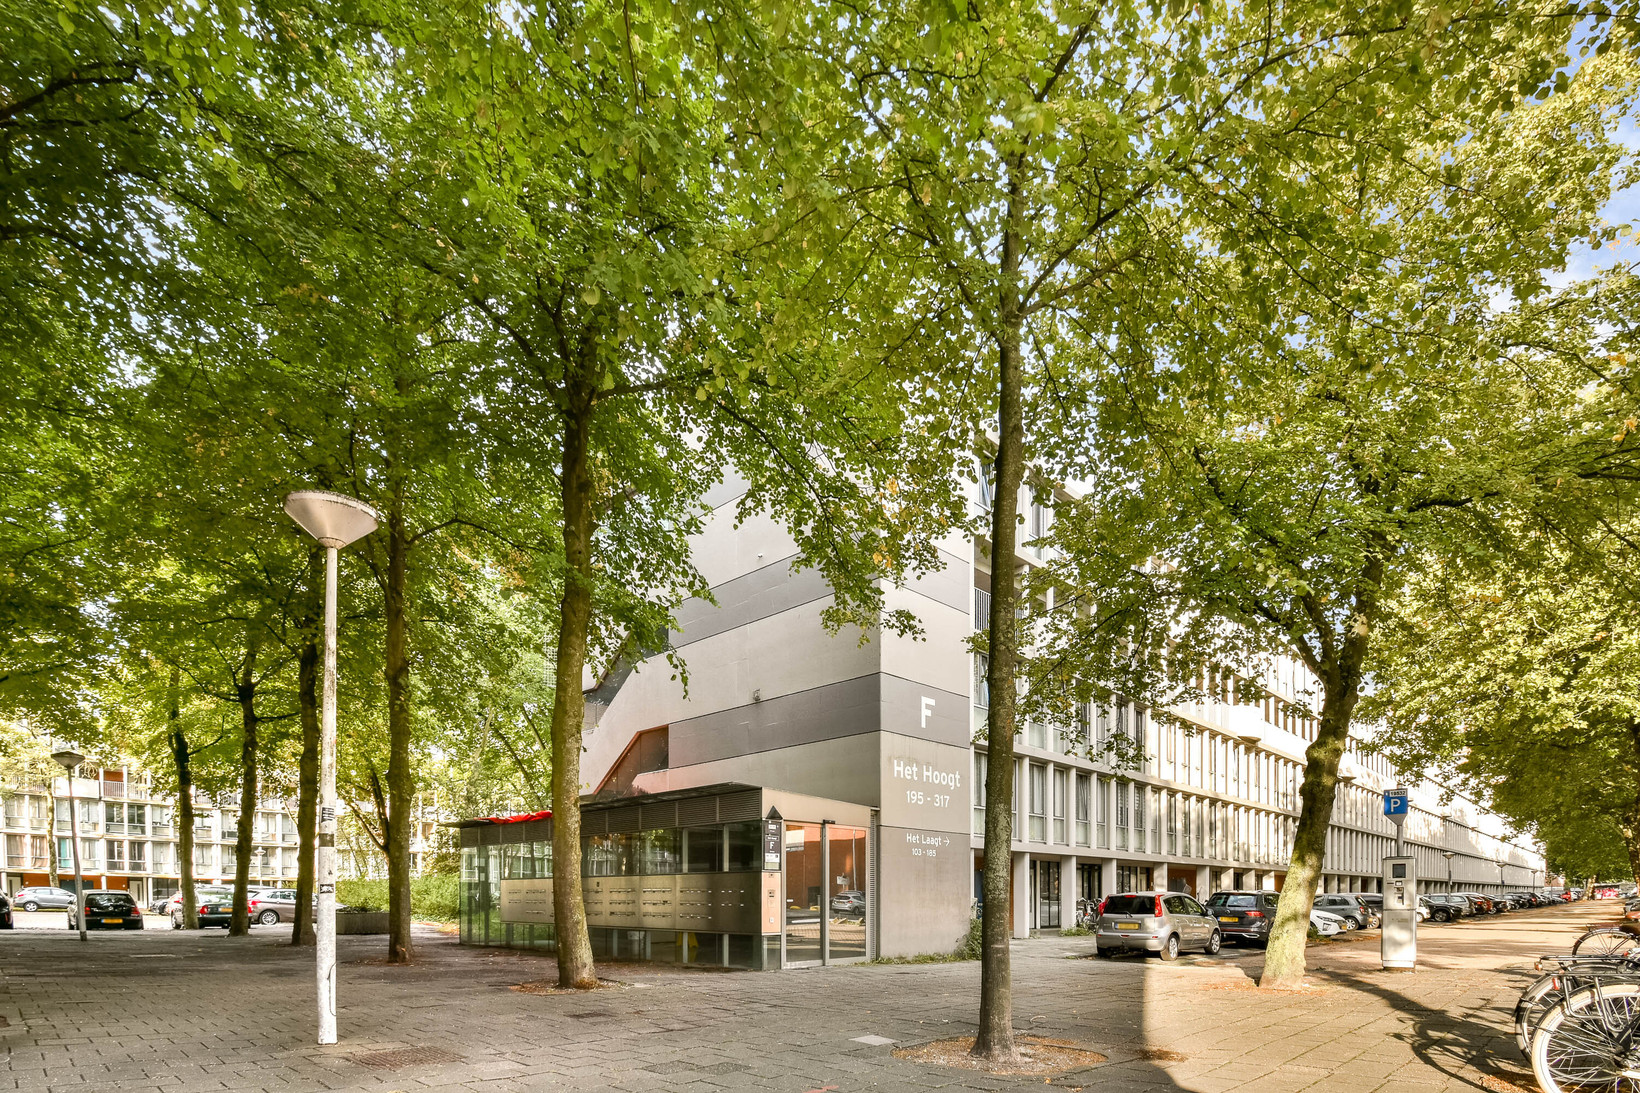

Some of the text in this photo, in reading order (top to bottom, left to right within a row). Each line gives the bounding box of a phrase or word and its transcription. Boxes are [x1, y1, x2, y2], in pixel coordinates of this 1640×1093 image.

[921, 695, 935, 728] F
[893, 759, 961, 790] Het Hoogt
[906, 790, 924, 805] 195
[933, 793, 950, 808] 317
[1391, 798, 1401, 812] P
[769, 841, 775, 849] F
[906, 832, 942, 848] Het Laagt
[911, 847, 922, 856] 103
